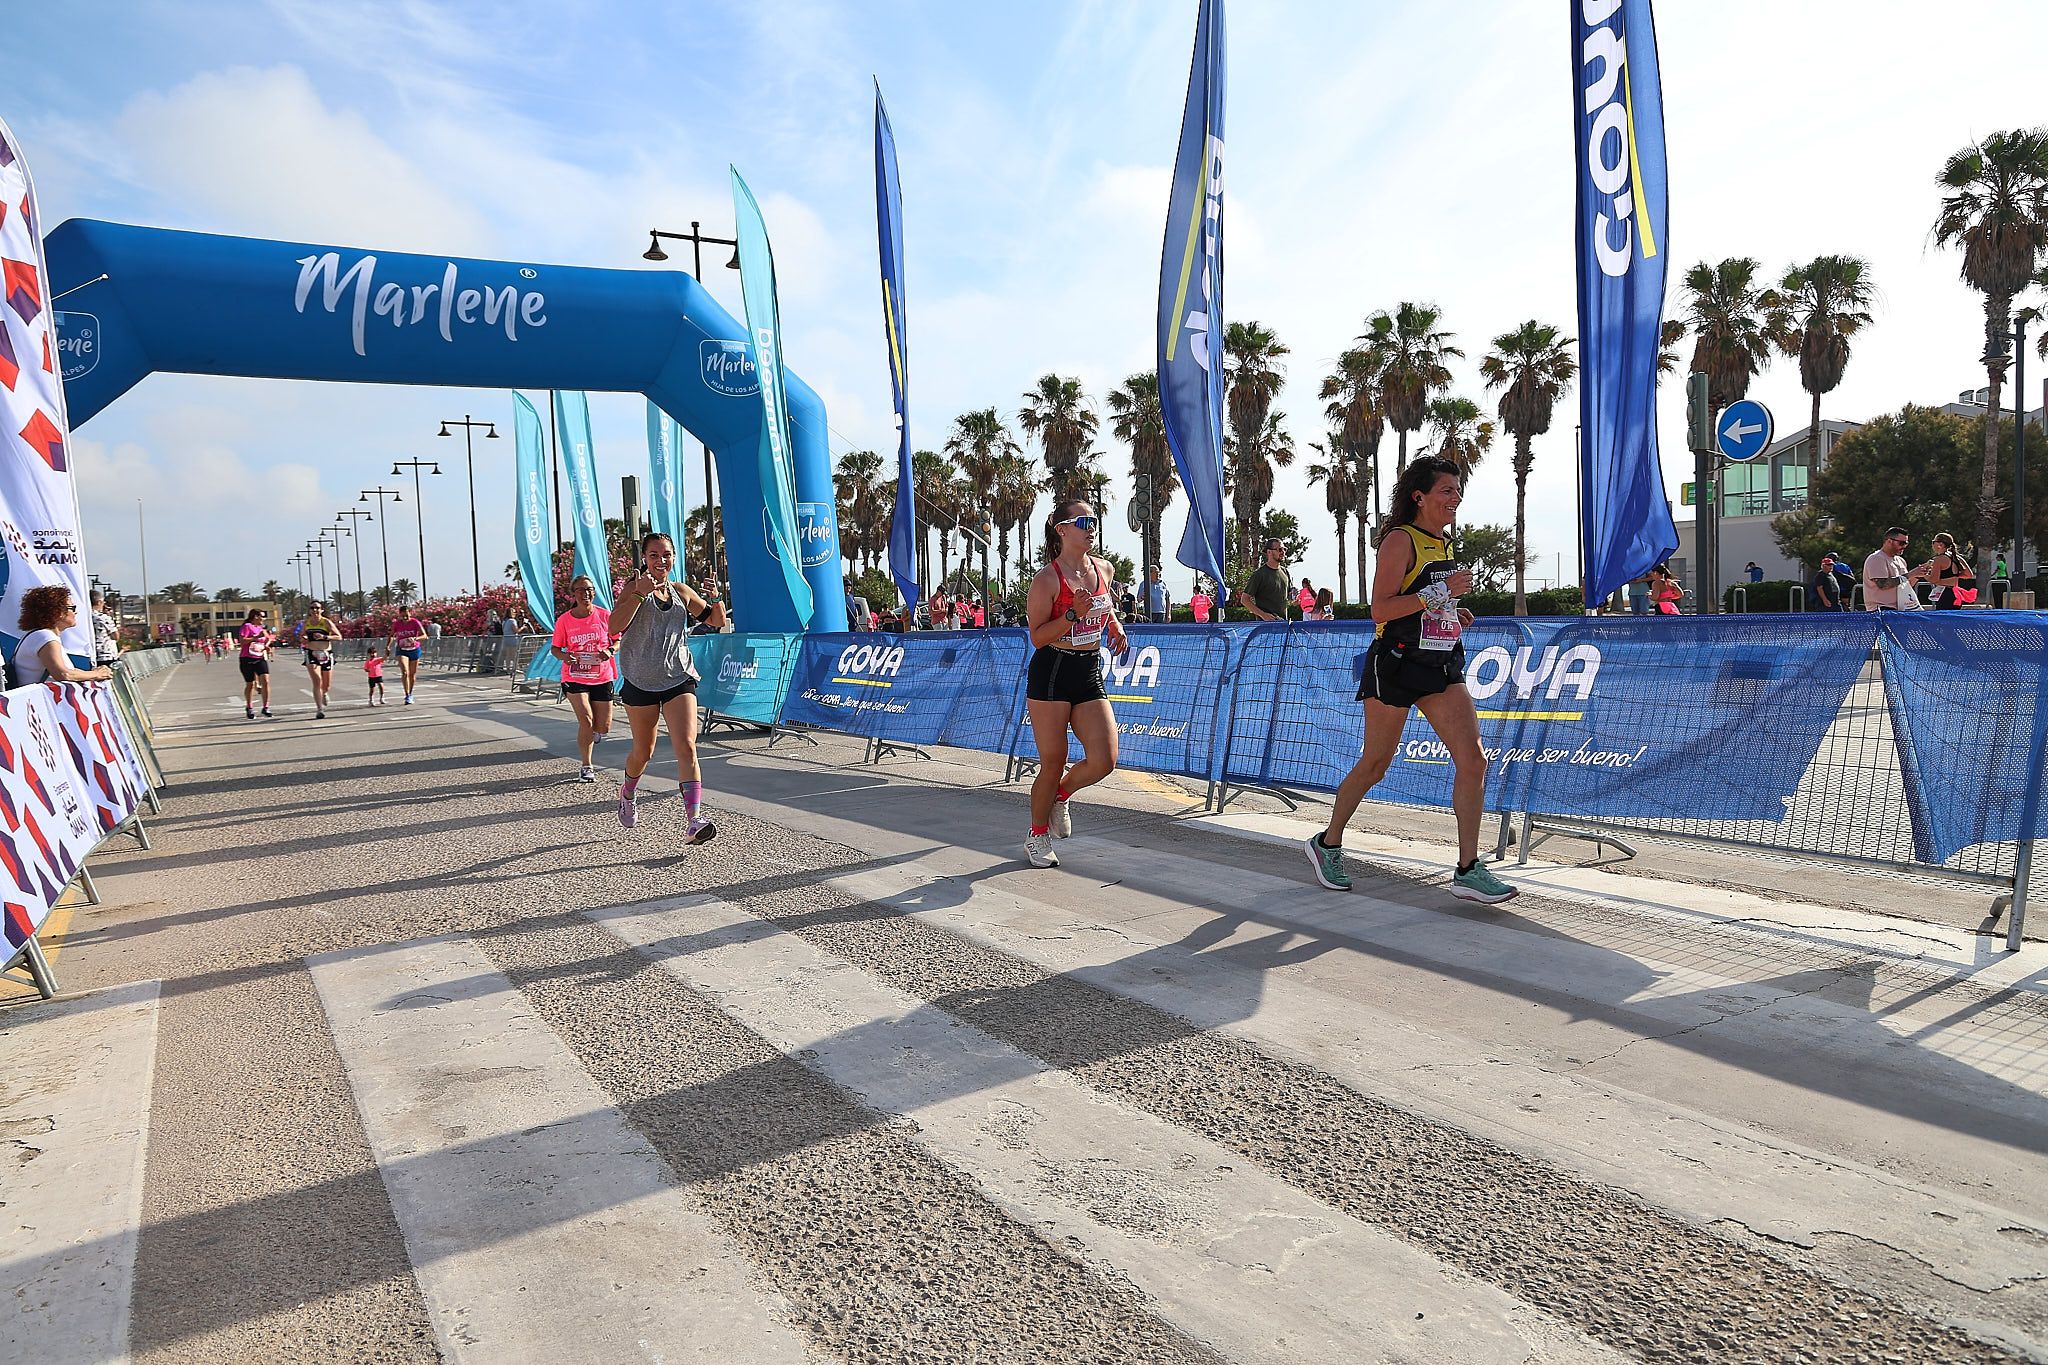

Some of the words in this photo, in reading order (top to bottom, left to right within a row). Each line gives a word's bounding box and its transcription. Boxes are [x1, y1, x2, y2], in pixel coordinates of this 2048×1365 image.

[717, 653, 759, 682] Compeed
[838, 644, 905, 677] GOYA
[1100, 645, 1160, 688] OYA
[1464, 644, 1601, 700] OYA
[821, 694, 841, 705] GOYA
[884, 697, 910, 714] bueno!
[1130, 722, 1148, 735] ser
[1148, 716, 1187, 739] bueno!
[1499, 748, 1534, 776] que
[1536, 747, 1568, 765] ser
[1569, 737, 1647, 768] bueno!
